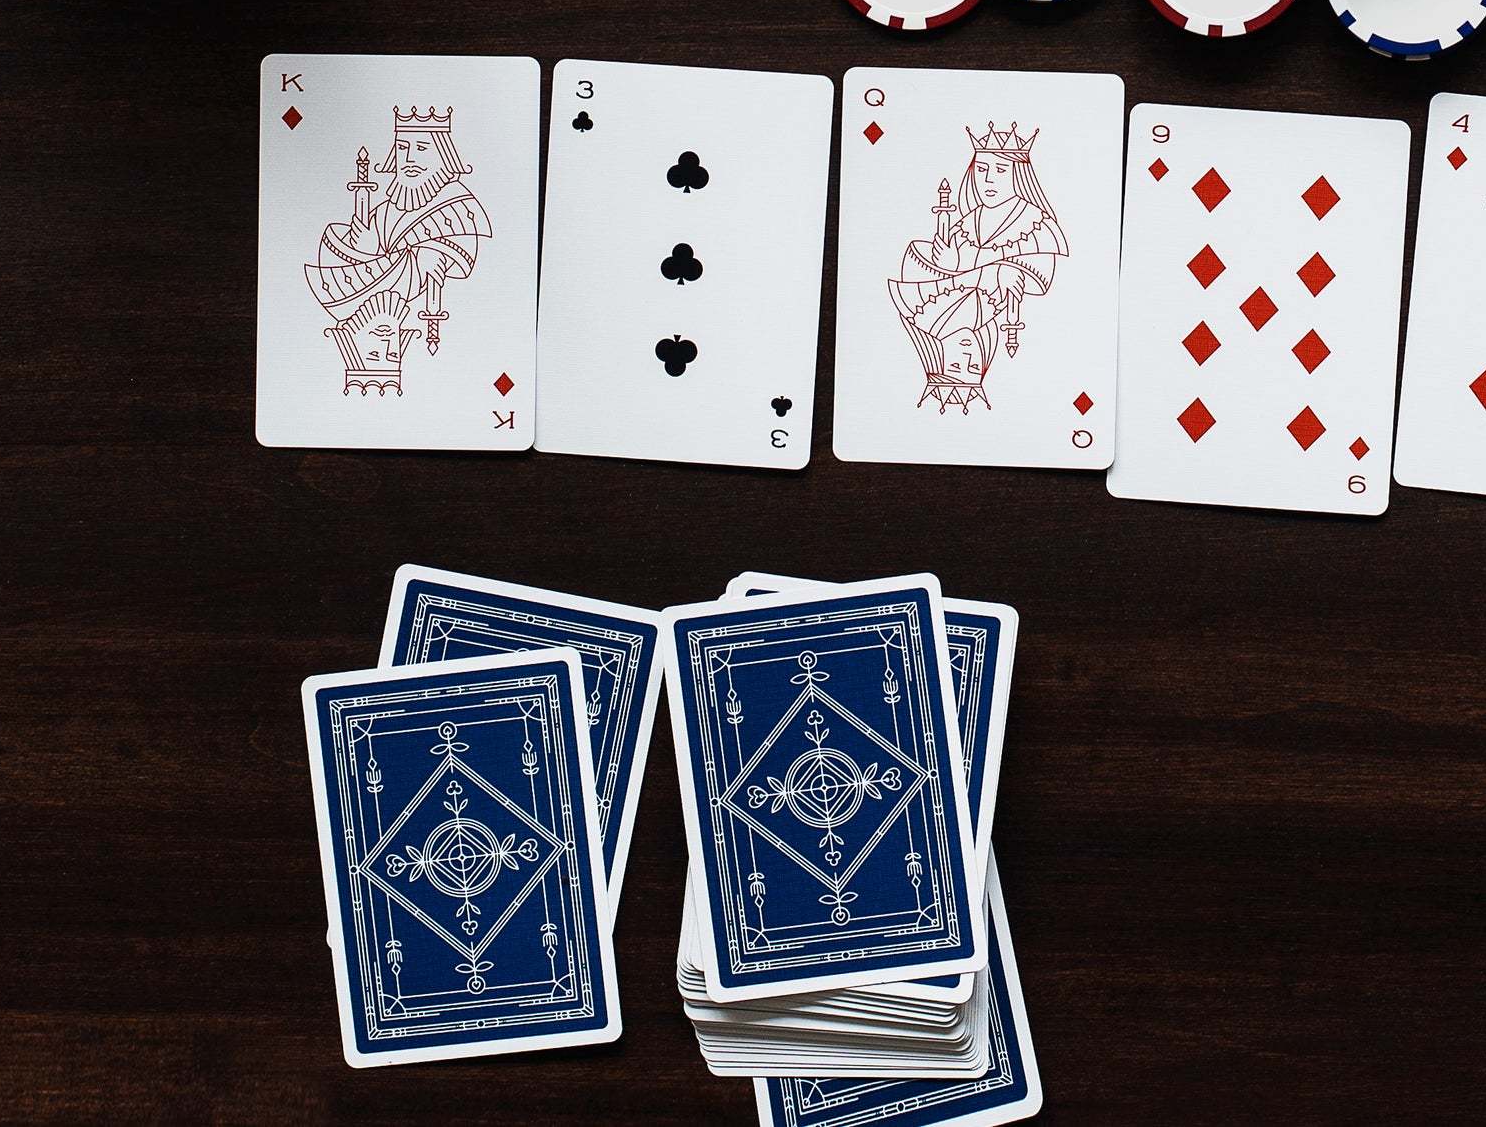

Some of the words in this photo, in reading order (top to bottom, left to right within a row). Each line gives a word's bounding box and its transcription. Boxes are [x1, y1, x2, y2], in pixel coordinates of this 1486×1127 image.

[281, 73, 305, 93] K
[575, 80, 595, 100] 3
[863, 87, 886, 107] Q
[1451, 113, 1470, 134] 4
[1151, 124, 1171, 144] 9
[492, 410, 515, 430] K
[770, 428, 790, 448] 3
[1071, 429, 1094, 450] Q
[1347, 474, 1367, 495] 9
